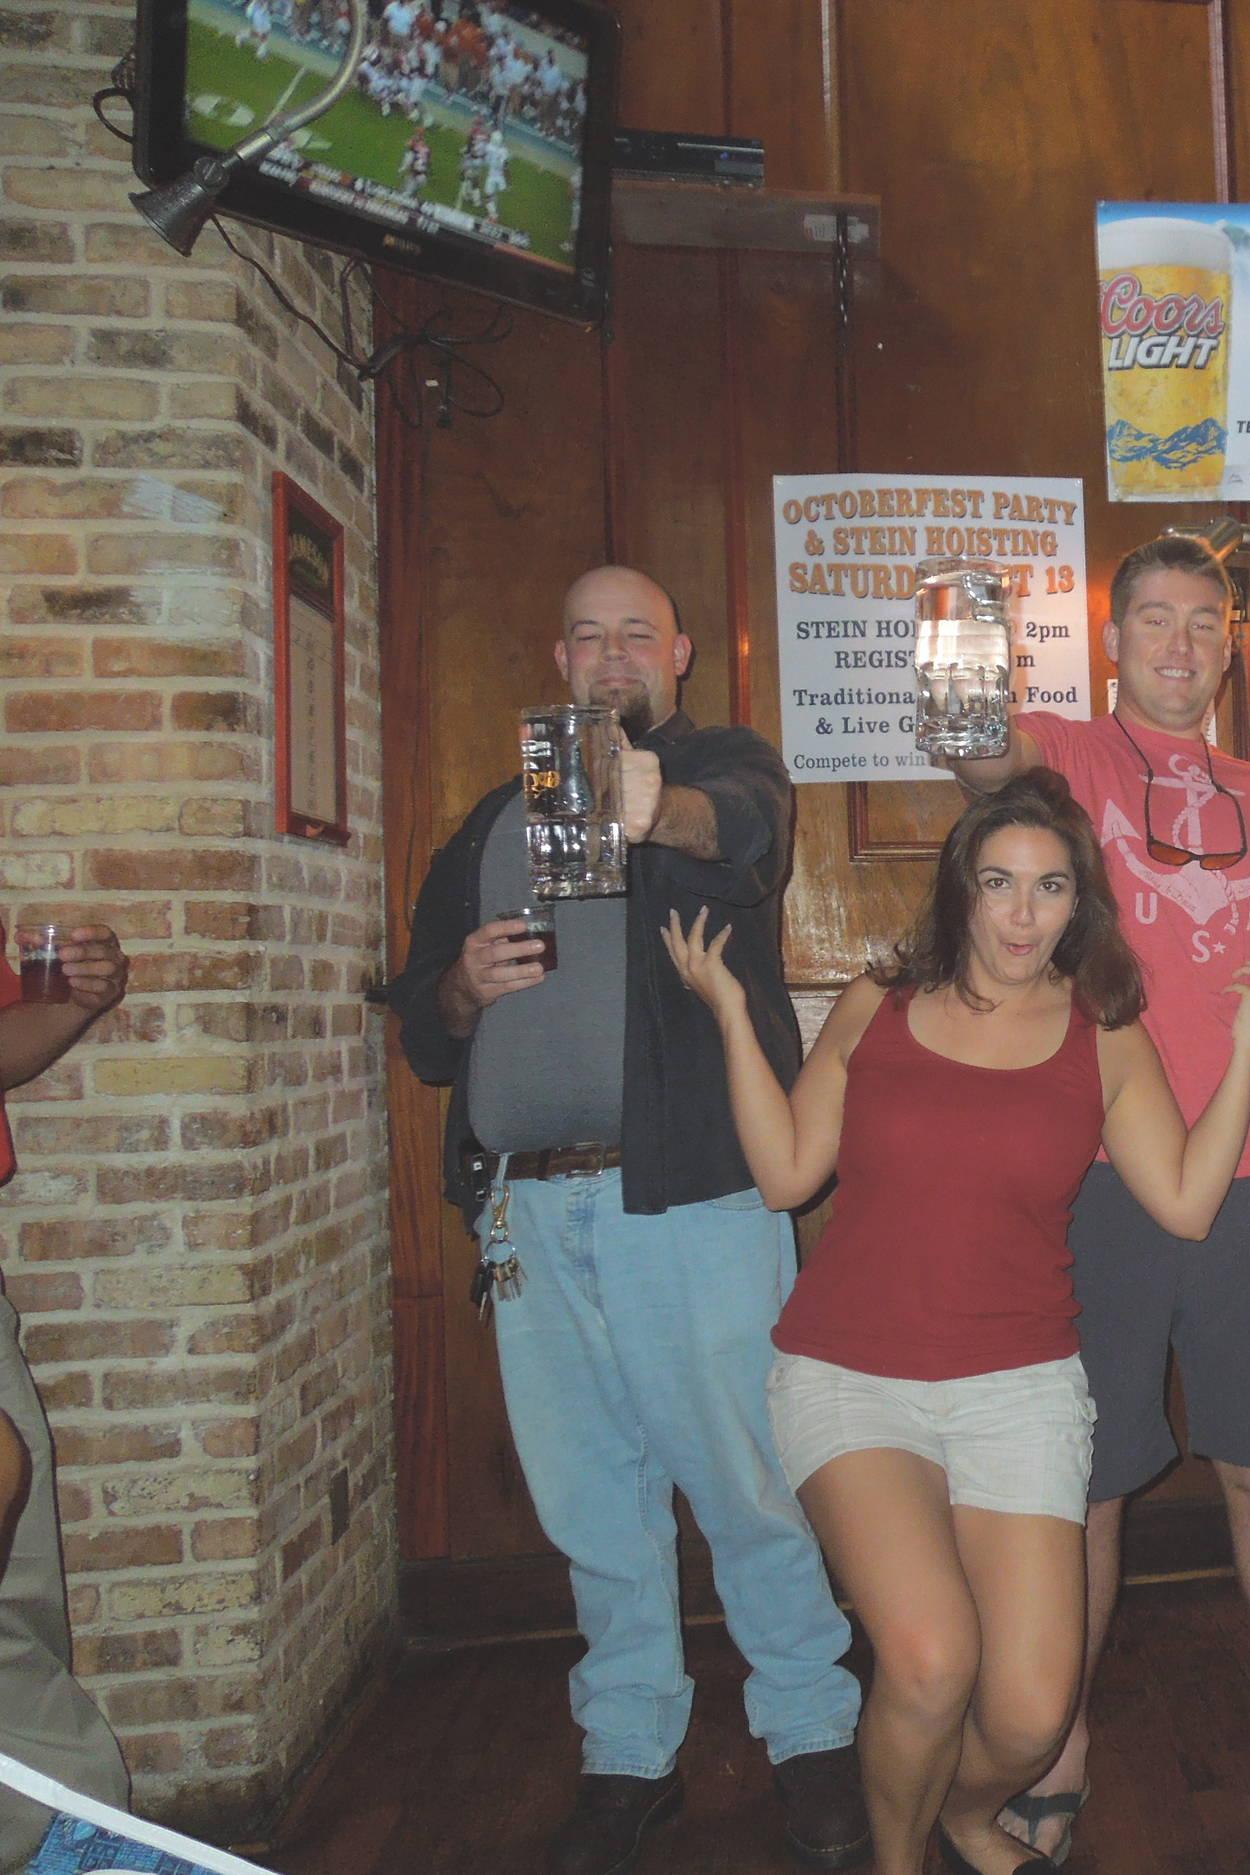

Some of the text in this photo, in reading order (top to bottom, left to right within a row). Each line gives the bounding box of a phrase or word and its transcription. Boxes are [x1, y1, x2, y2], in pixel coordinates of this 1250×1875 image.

[1099, 274, 1225, 338] Coors
[1107, 335, 1221, 370] LIGHT
[782, 487, 1078, 526] OCTOBERFEST PARTY
[804, 525, 1059, 557] & STEIN HOISTING
[788, 562, 918, 601] SATURD
[1045, 564, 1076, 595] 13
[796, 619, 868, 640] STEIN
[1025, 621, 1071, 643] 2pm
[792, 687, 916, 708] Traditiona
[1025, 686, 1078, 705] Food
[814, 717, 834, 735] &
[842, 714, 891, 735] Live
[793, 751, 927, 773] Compete to win
